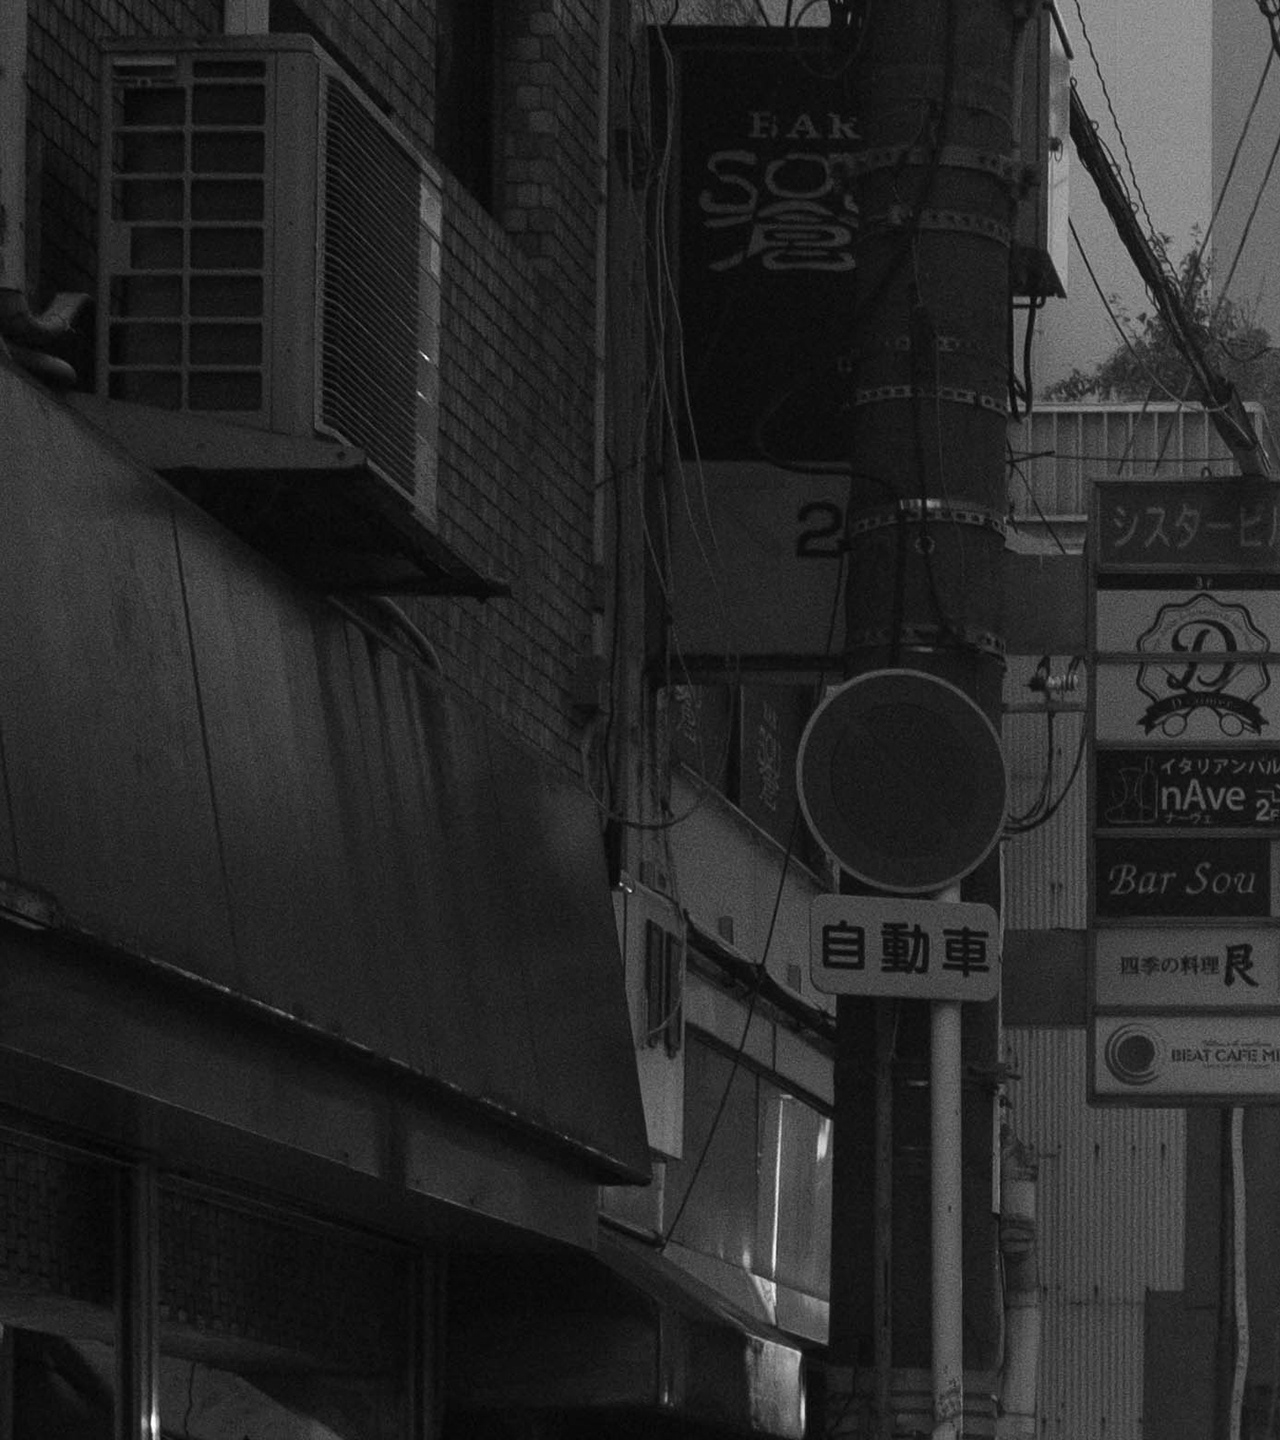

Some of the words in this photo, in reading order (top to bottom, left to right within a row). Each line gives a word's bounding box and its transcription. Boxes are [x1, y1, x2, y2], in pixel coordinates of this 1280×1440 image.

[1161, 778, 1247, 812] nAve
[1108, 862, 1177, 895] Bar
[1184, 861, 1257, 896] Sou
[822, 920, 990, 978] 自動車
[1120, 955, 1221, 976] 四季の料理
[1171, 1048, 1213, 1062] BEAT
[1215, 1048, 1258, 1062] CAFE
